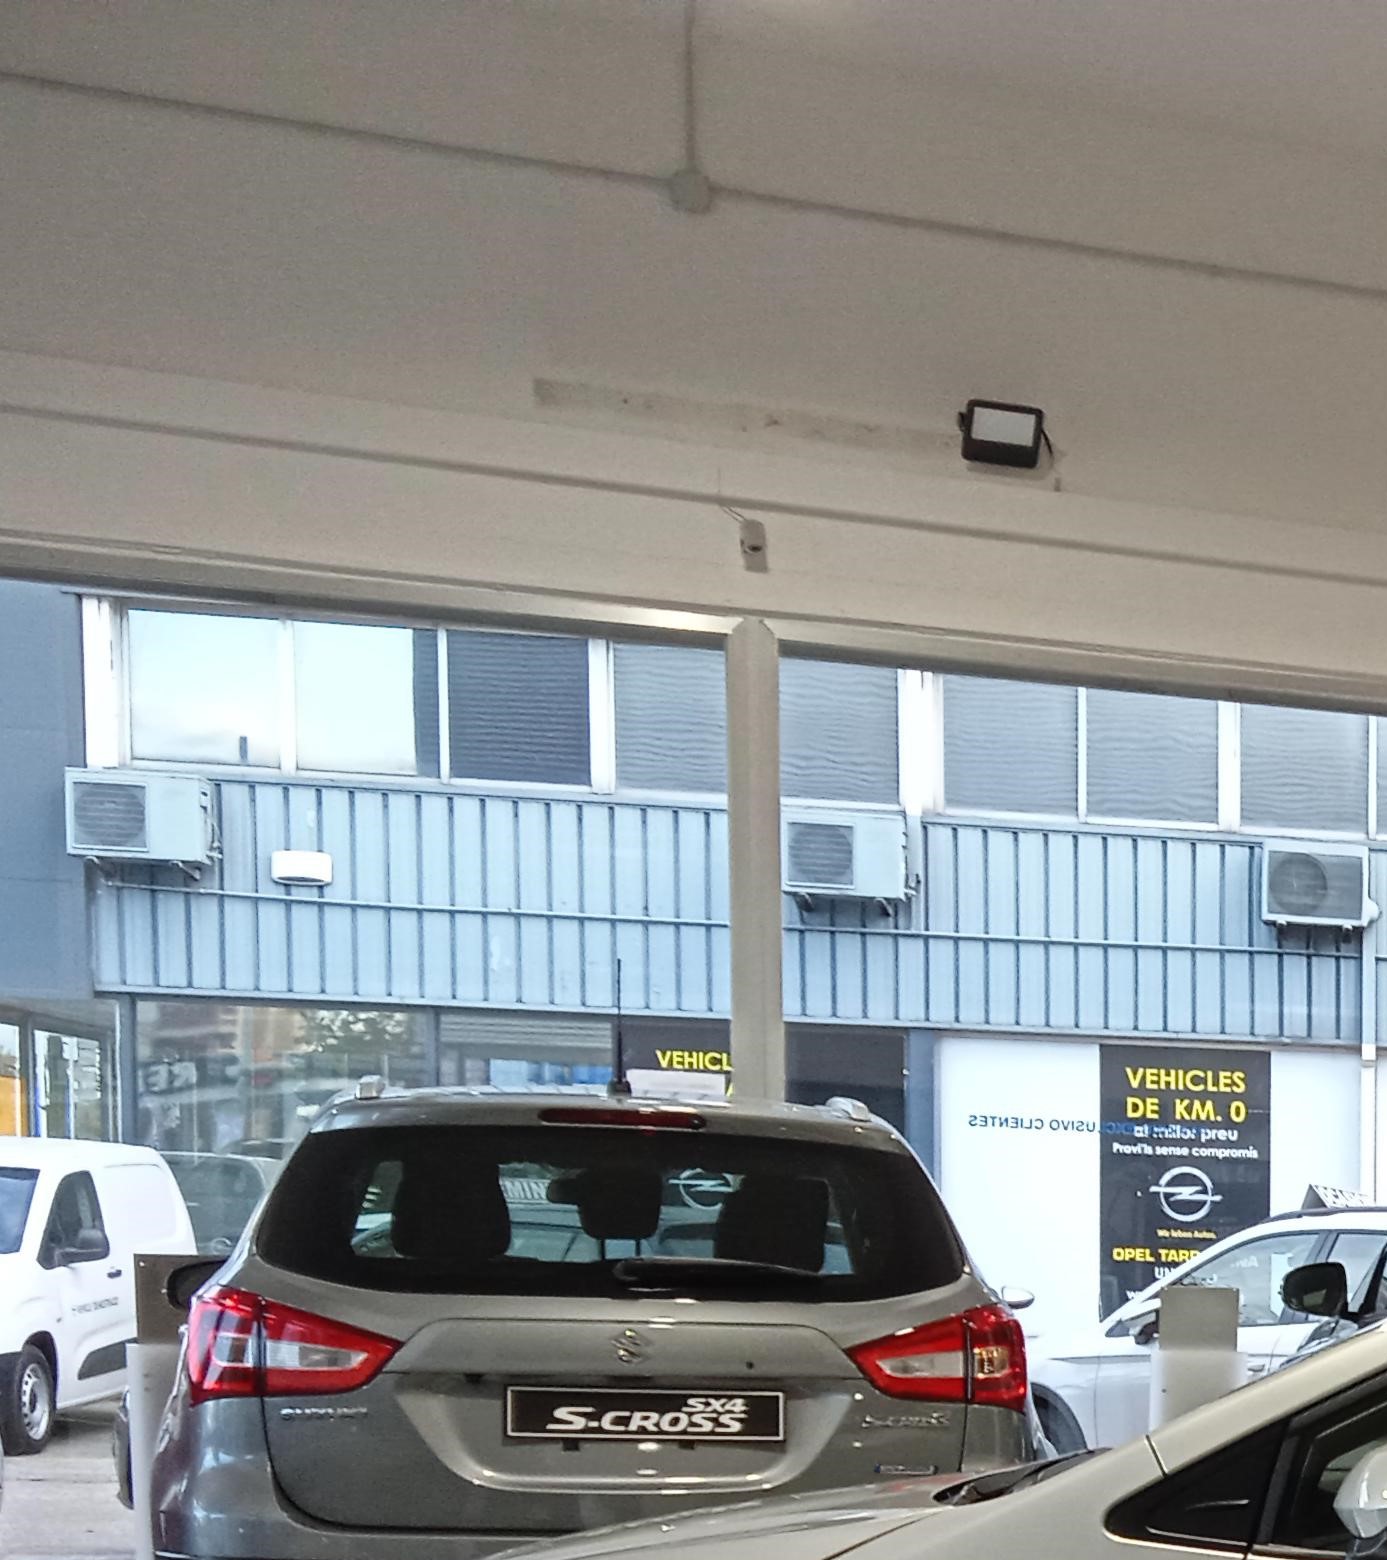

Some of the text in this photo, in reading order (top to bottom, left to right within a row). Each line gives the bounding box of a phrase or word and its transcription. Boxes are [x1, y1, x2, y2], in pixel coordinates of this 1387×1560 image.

[1125, 1066, 1247, 1094] VEHICLES
[1126, 1096, 1247, 1124] DE KM. 0
[1200, 1128, 1239, 1143] preu
[1155, 1144, 1190, 1157] sense
[1112, 1247, 1155, 1262] OPEL
[681, 1397, 749, 1414] SX4
[545, 1406, 749, 1433] S-CROSS
